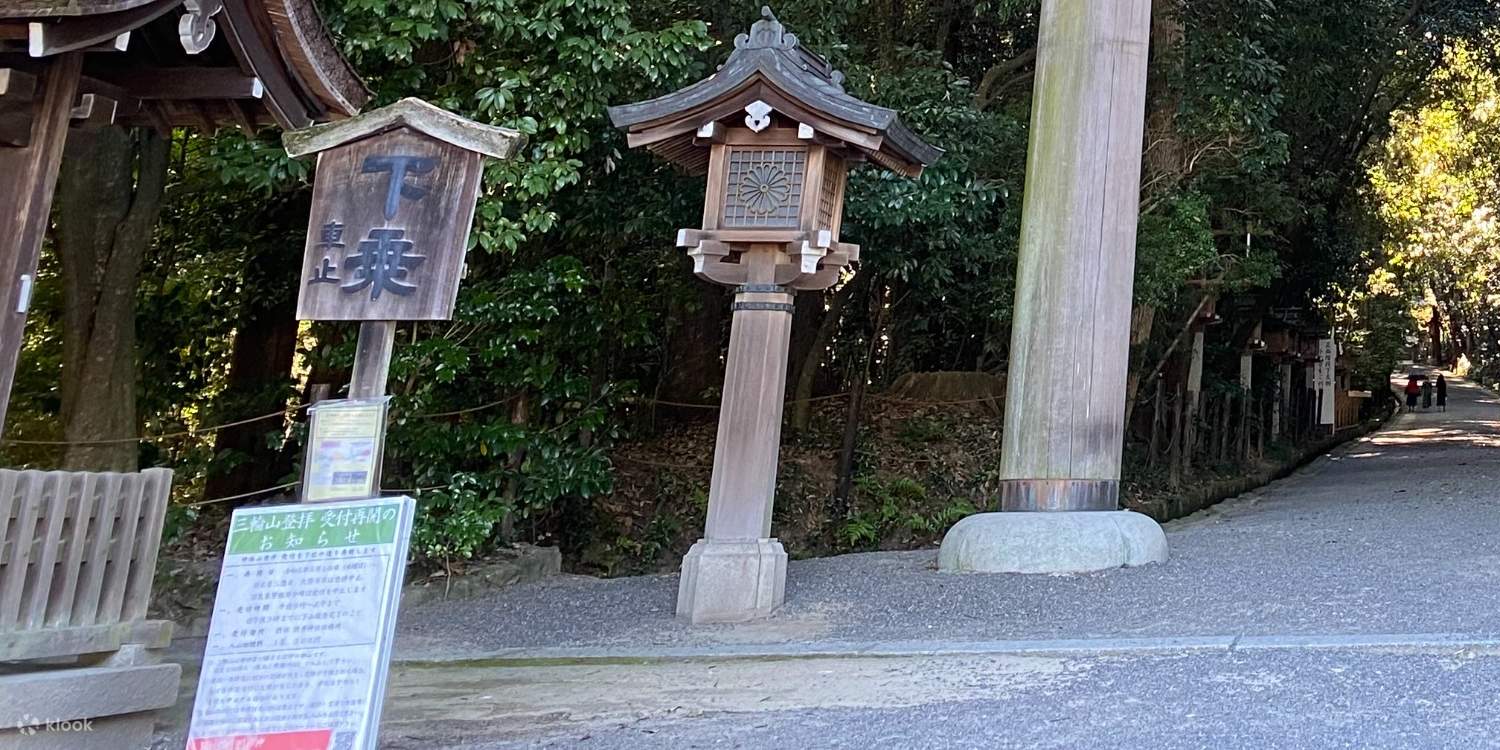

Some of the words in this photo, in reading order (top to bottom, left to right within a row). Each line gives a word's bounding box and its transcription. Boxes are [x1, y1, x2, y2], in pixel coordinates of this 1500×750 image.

[308, 220, 345, 284] 車止
[320, 508, 397, 528] 受付再開の
